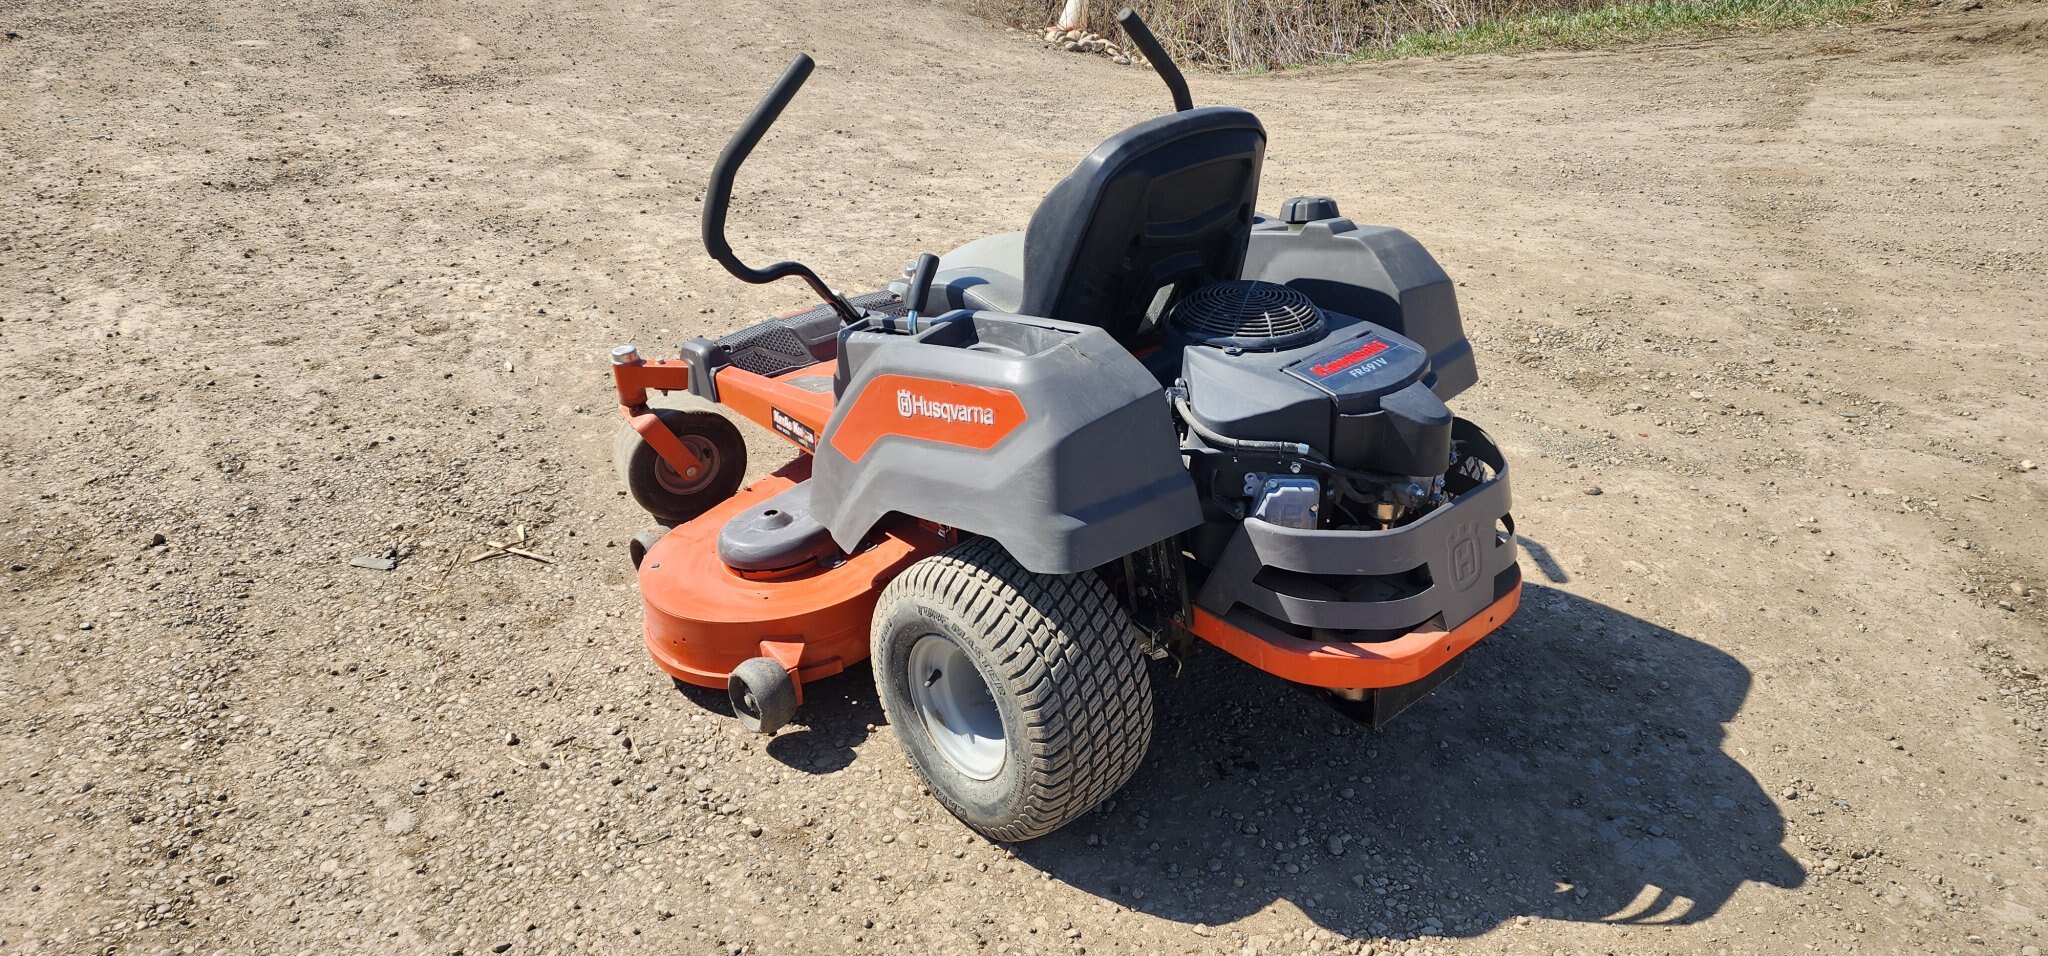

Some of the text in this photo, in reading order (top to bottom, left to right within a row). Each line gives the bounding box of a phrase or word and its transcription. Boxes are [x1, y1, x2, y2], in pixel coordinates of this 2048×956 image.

[1309, 340, 1390, 378] Kawasaki
[1348, 357, 1388, 378] FR691V
[913, 394, 995, 426] Husqvarna
